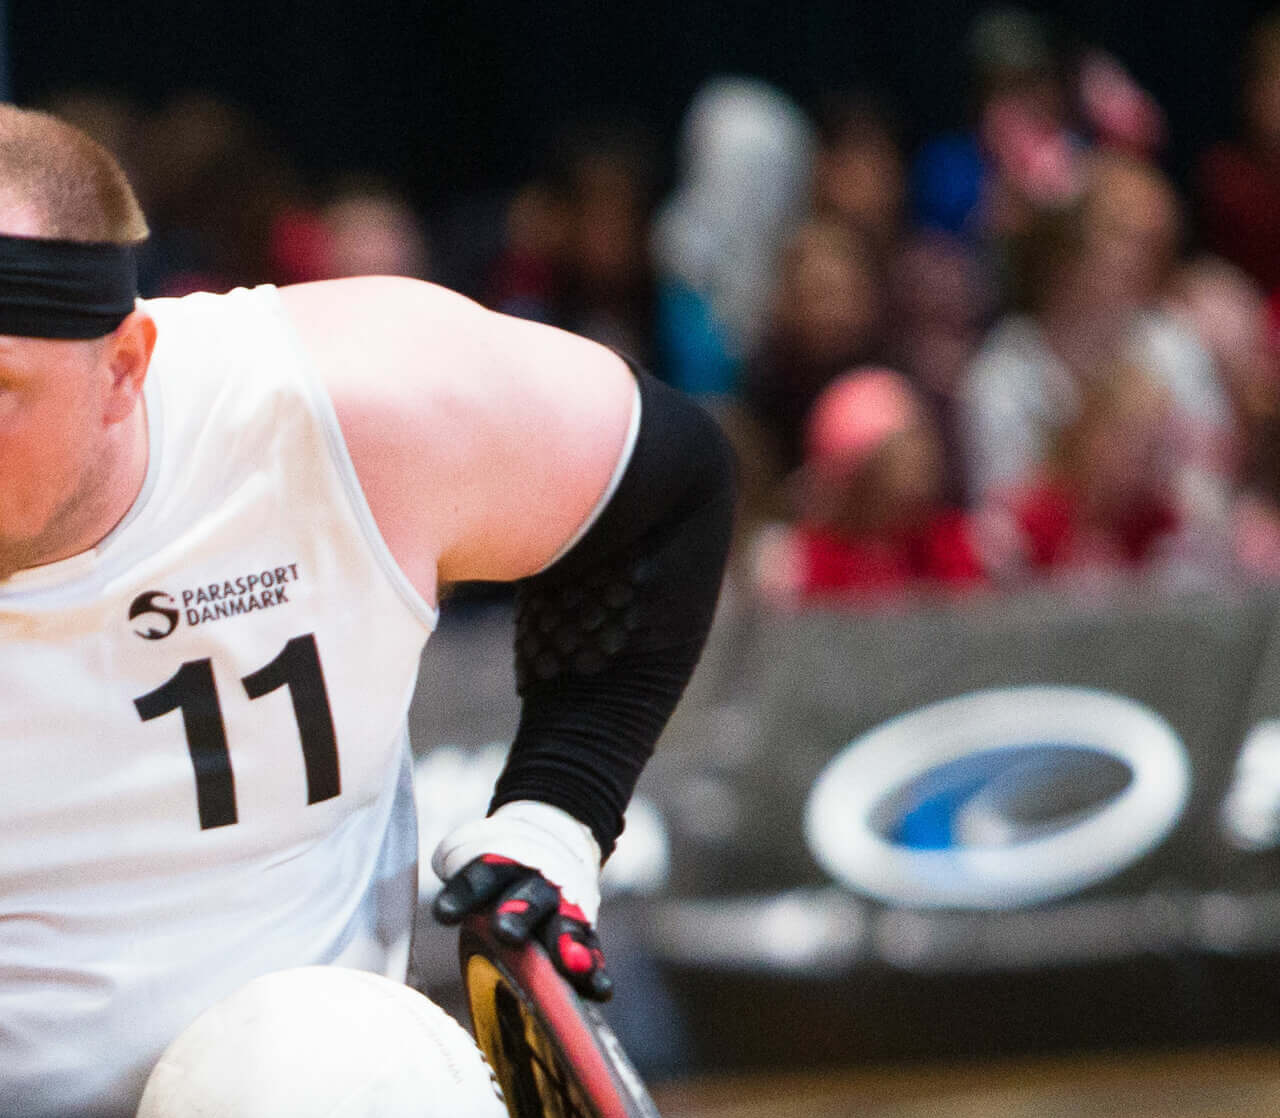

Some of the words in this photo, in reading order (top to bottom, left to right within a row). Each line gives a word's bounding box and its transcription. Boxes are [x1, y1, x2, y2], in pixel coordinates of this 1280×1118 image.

[182, 563, 299, 607] PARASPORT
[186, 586, 288, 626] DANMARK
[133, 633, 342, 831] 11
